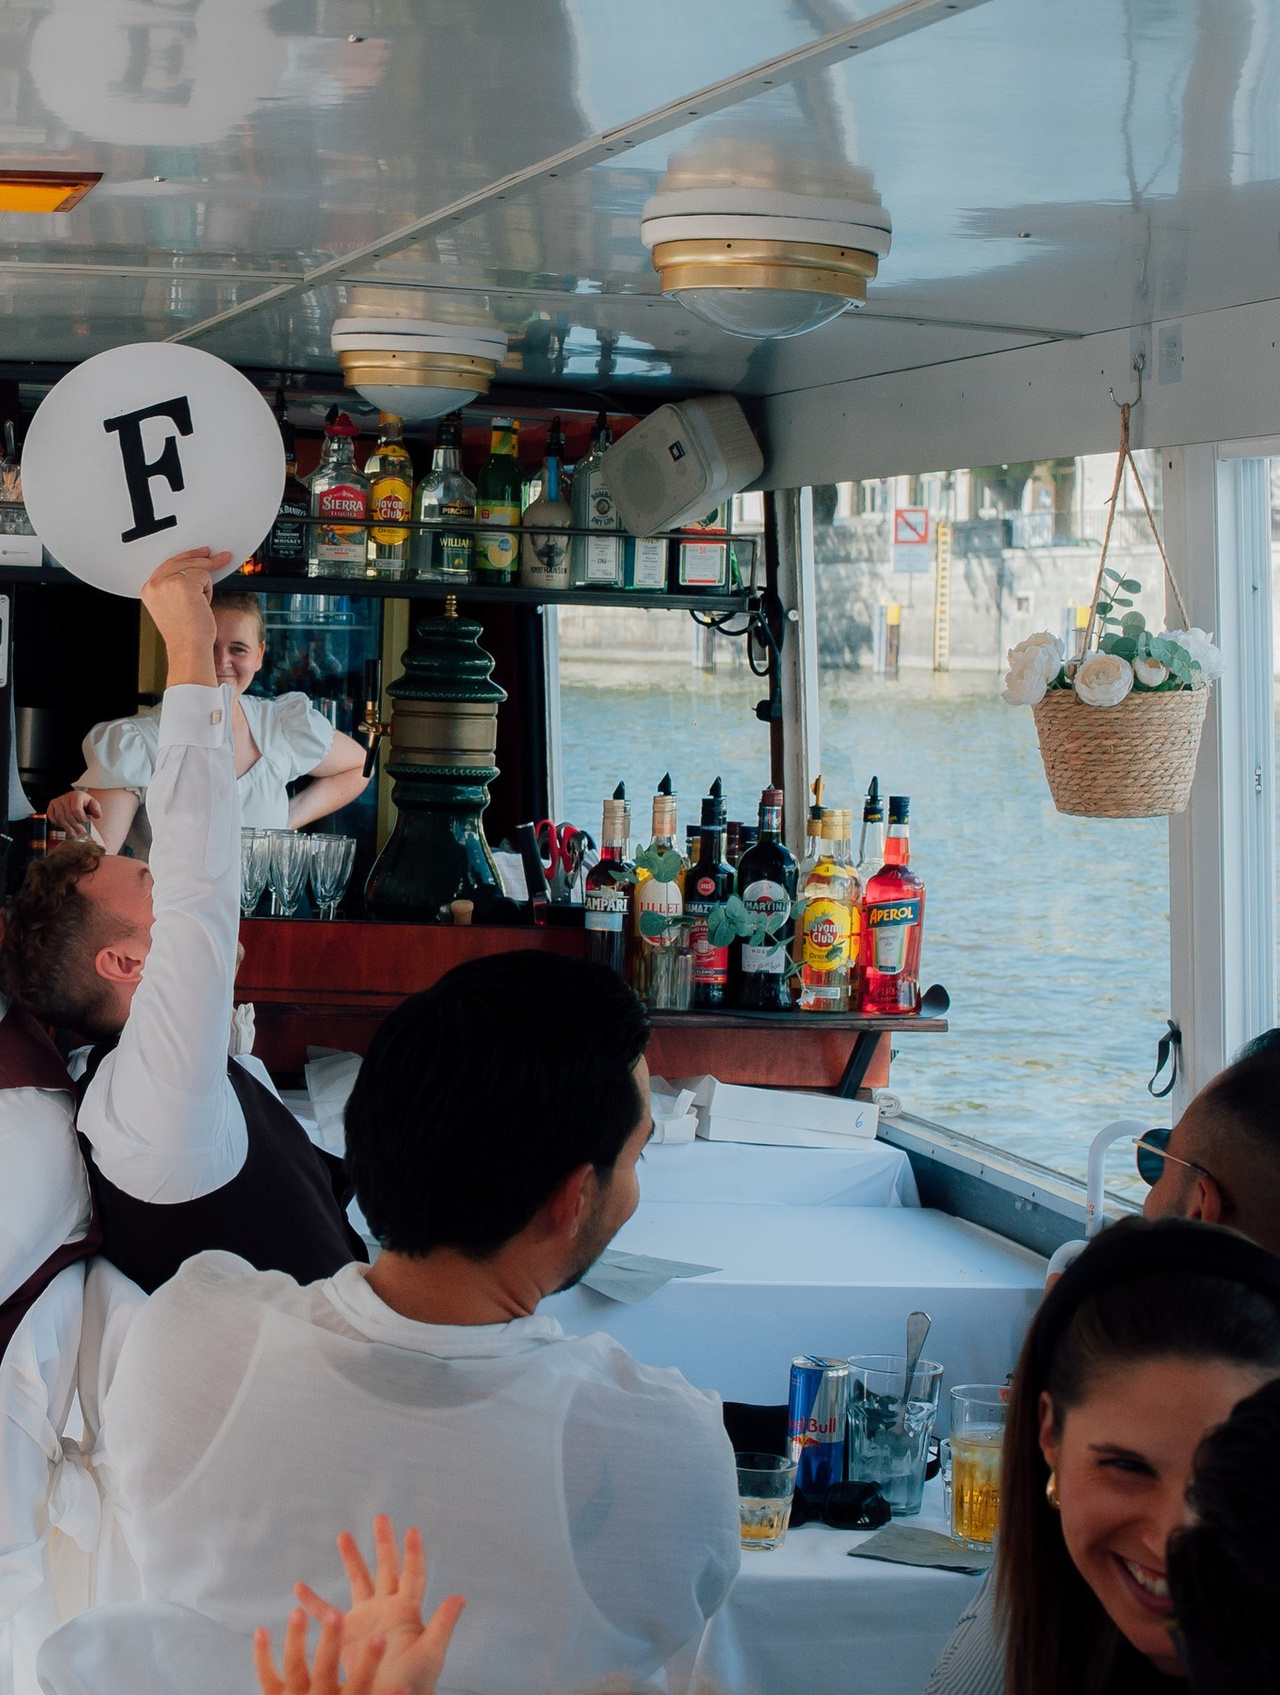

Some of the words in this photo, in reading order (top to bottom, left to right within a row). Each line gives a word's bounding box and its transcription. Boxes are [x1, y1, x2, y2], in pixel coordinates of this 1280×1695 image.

[103, 395, 194, 543] F
[322, 494, 364, 512] SIERRA
[381, 508, 402, 519] Club
[585, 897, 629, 912] AMPARI
[640, 901, 680, 914] LILLET
[745, 901, 786, 911] MARTINI
[869, 905, 914, 925] APEROL
[812, 932, 834, 944] Club
[855, 1111, 864, 1129] 6
[807, 1417, 837, 1434] Bull
